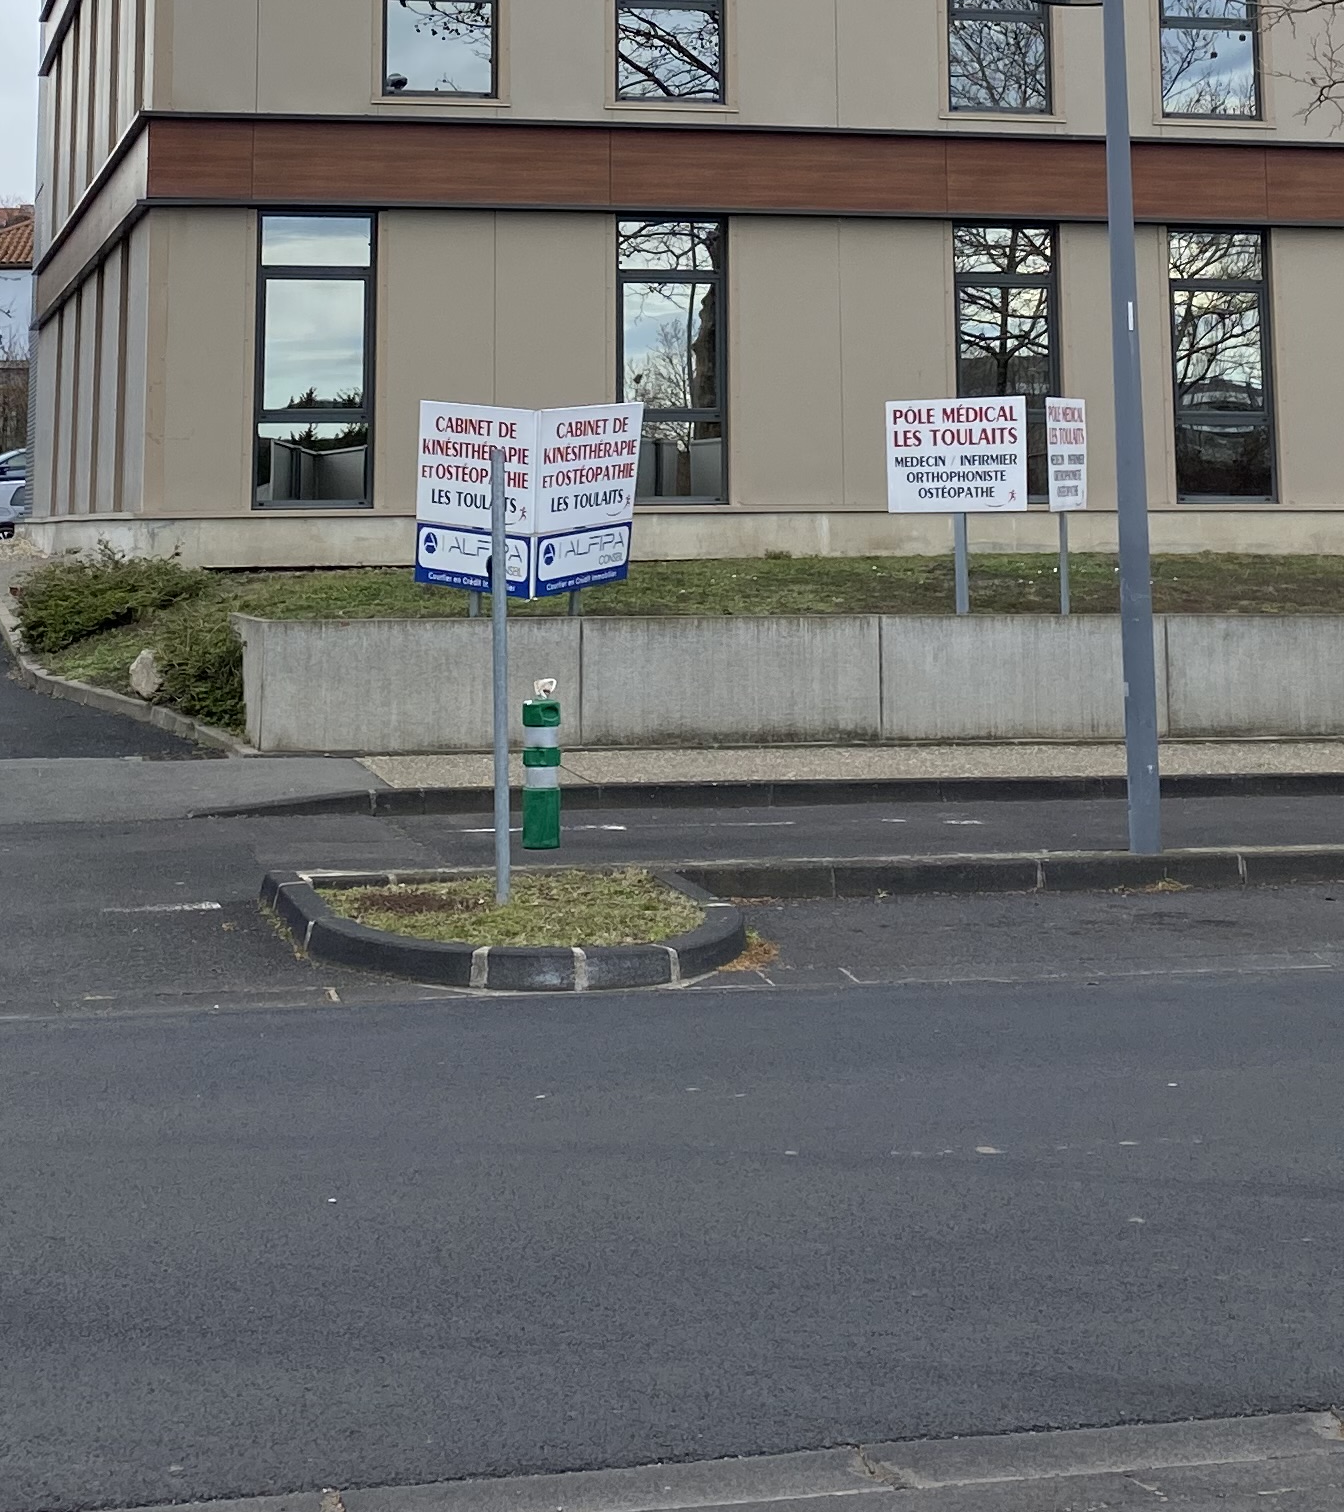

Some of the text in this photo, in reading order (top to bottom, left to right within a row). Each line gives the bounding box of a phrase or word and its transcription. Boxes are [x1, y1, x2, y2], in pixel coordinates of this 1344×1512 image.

[893, 404, 1018, 425] PÔLE MÉDICAL
[436, 416, 517, 439] CABINET DE
[556, 417, 629, 439] CABINET DE
[893, 426, 1018, 448] LES TOULAITS
[543, 438, 638, 465] KINÉSITHÉRAPIE
[894, 455, 946, 468] MEDECIN
[960, 453, 1018, 466] INFIRMIER
[421, 462, 529, 490] ET OSTÉOPHIE
[542, 461, 636, 489] ET OSTÉOPATHIE
[906, 470, 1007, 484] ORTHOPHONISTE
[431, 488, 517, 514] LES TOULTS
[551, 488, 624, 513] LES TOULAITS
[918, 485, 996, 499] OSTÉOPATHE
